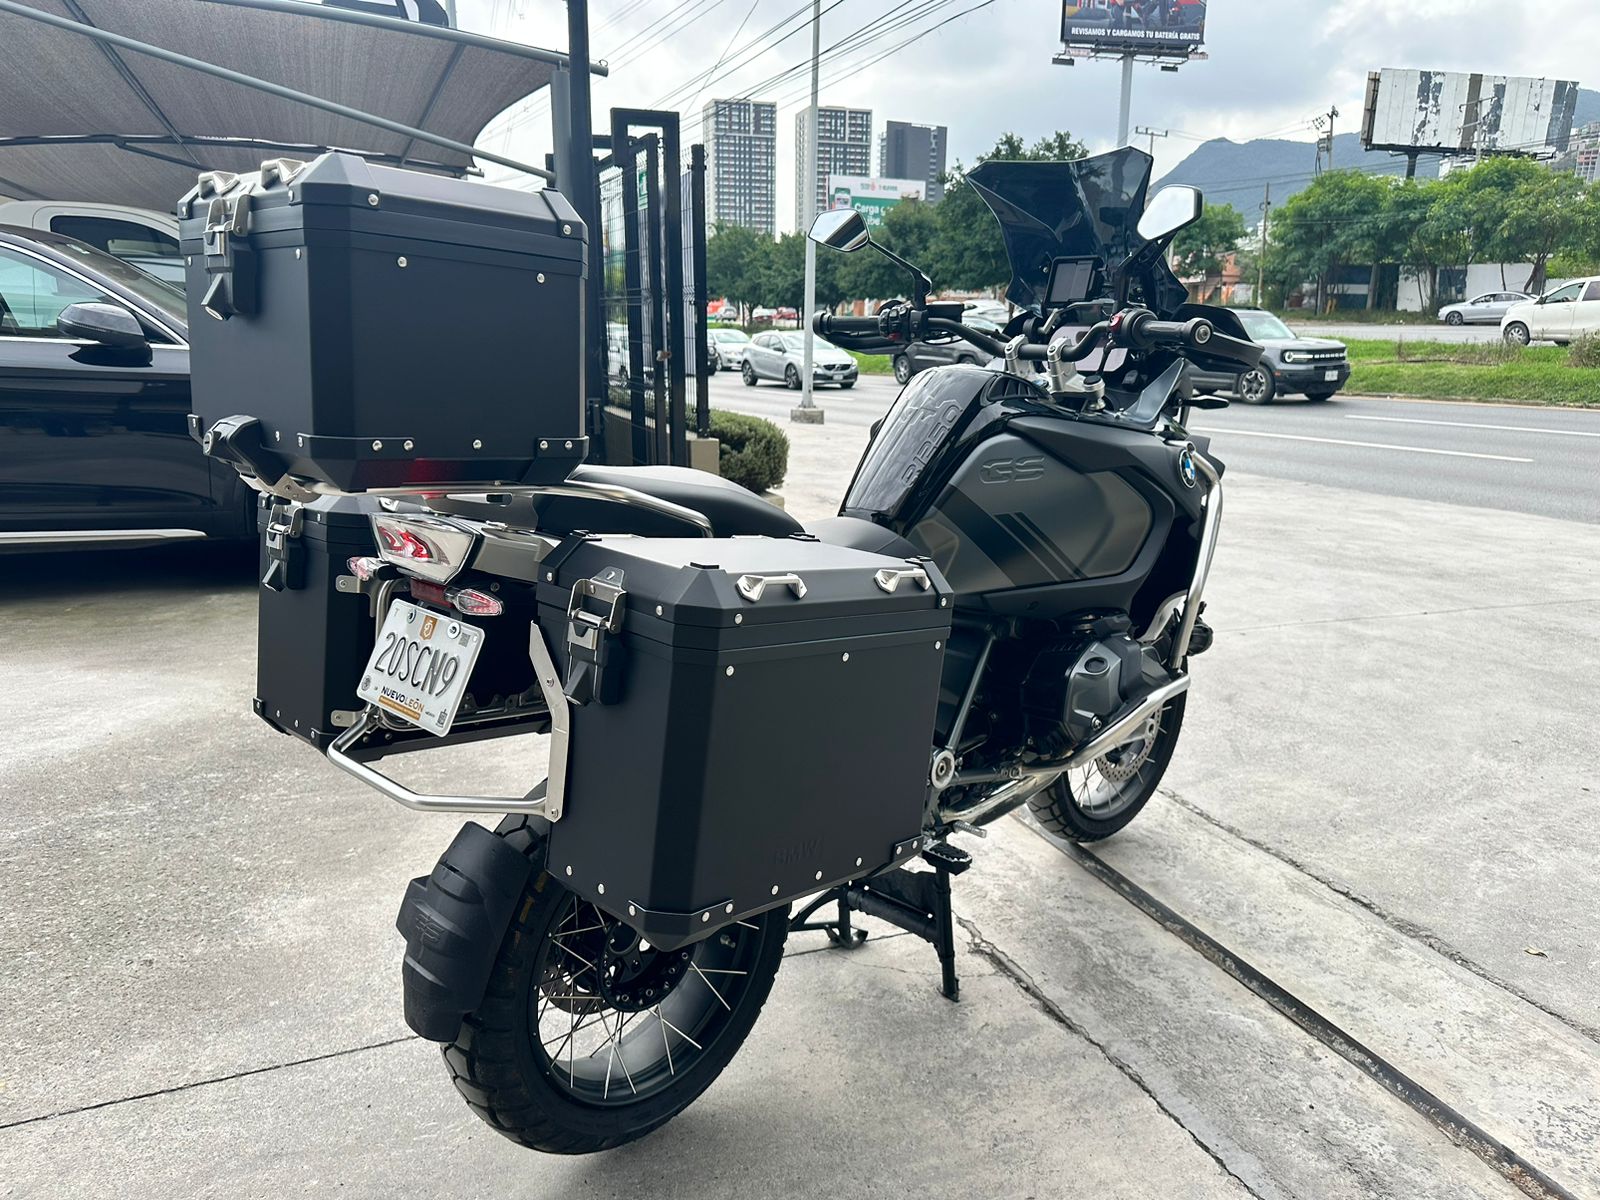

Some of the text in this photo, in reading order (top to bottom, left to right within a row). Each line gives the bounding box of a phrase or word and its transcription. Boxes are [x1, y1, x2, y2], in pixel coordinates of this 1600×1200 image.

[1071, 27, 1106, 36] REVISAMOS
[1112, 29, 1145, 38] CARGAMOS
[1146, 30, 1153, 38] TU
[1155, 31, 1178, 39] BATERÍA
[854, 203, 880, 216] Carga
[980, 456, 1045, 484] GS
[374, 631, 460, 697] 20SCN9
